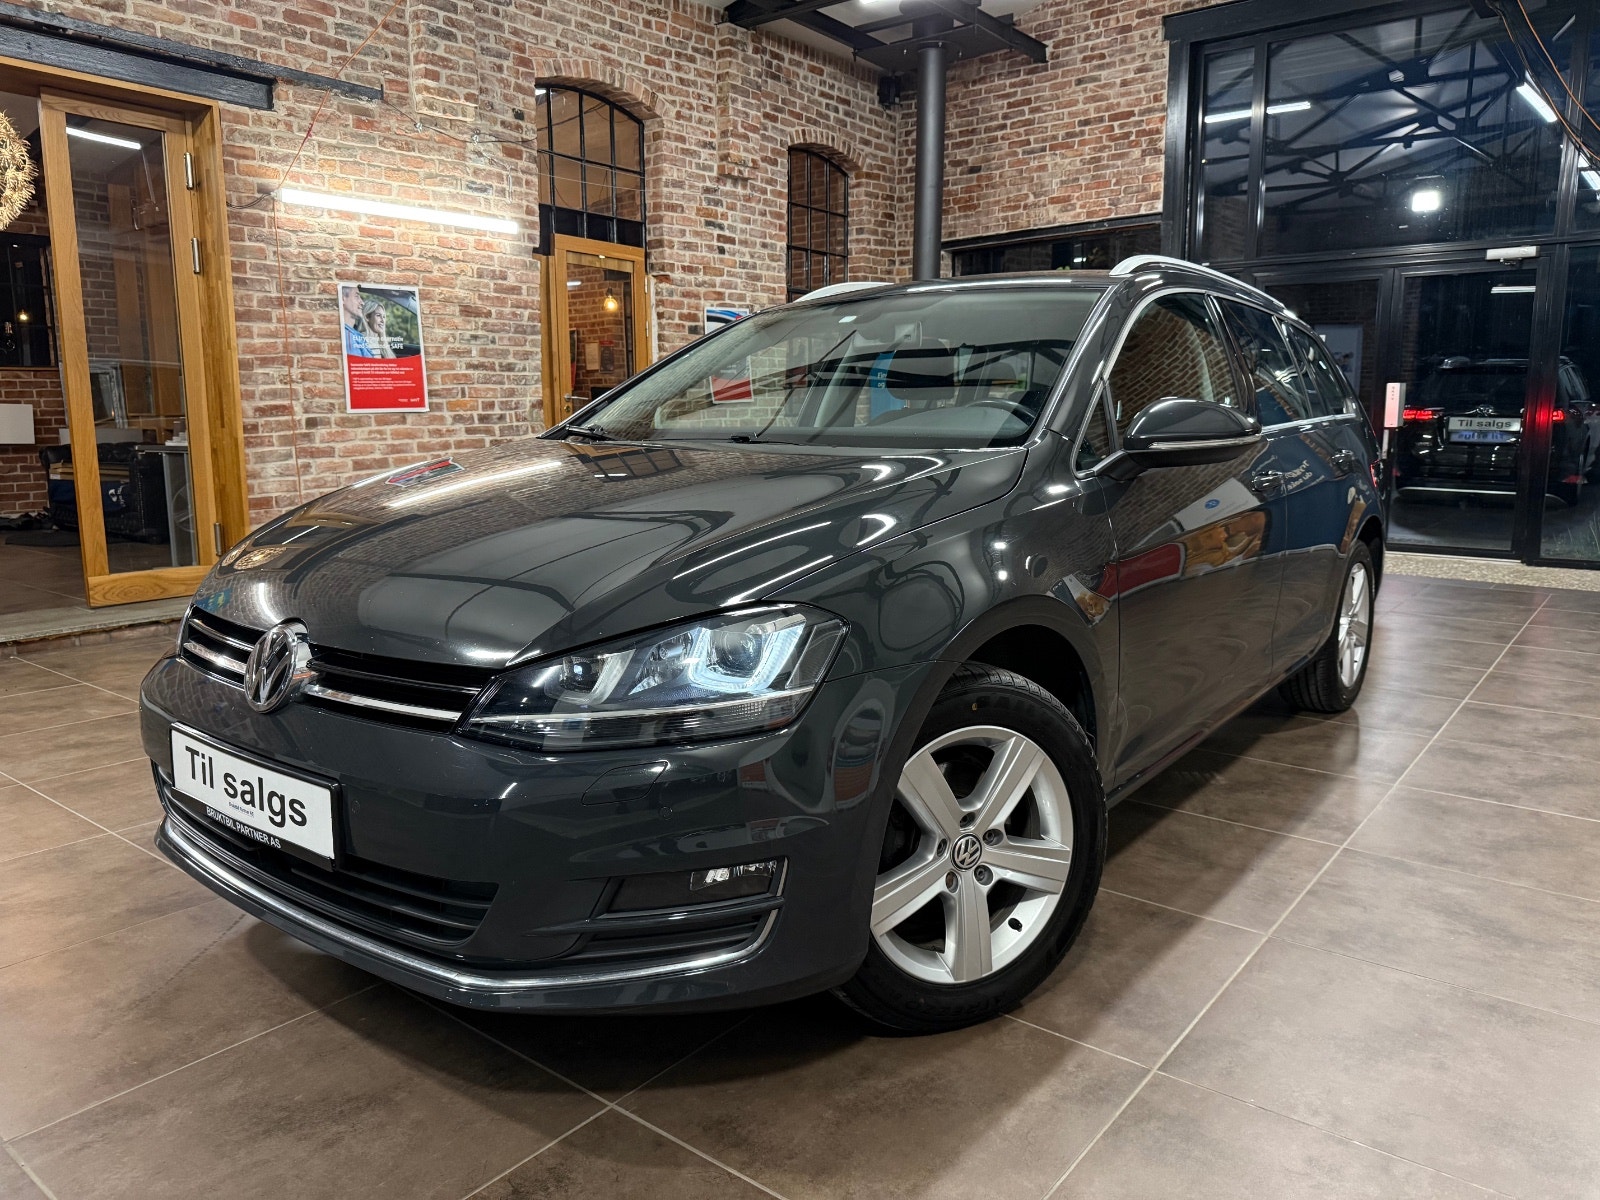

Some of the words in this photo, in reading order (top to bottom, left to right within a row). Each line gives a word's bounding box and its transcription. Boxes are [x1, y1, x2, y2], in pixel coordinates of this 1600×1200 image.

[1457, 419, 1473, 428] Til
[1476, 418, 1512, 430] salgs
[185, 745, 215, 790] Til
[223, 772, 307, 828] salgs
[206, 805, 236, 831] BRUKTBIL
[236, 821, 270, 845] PARTNER
[270, 836, 282, 849] AS
